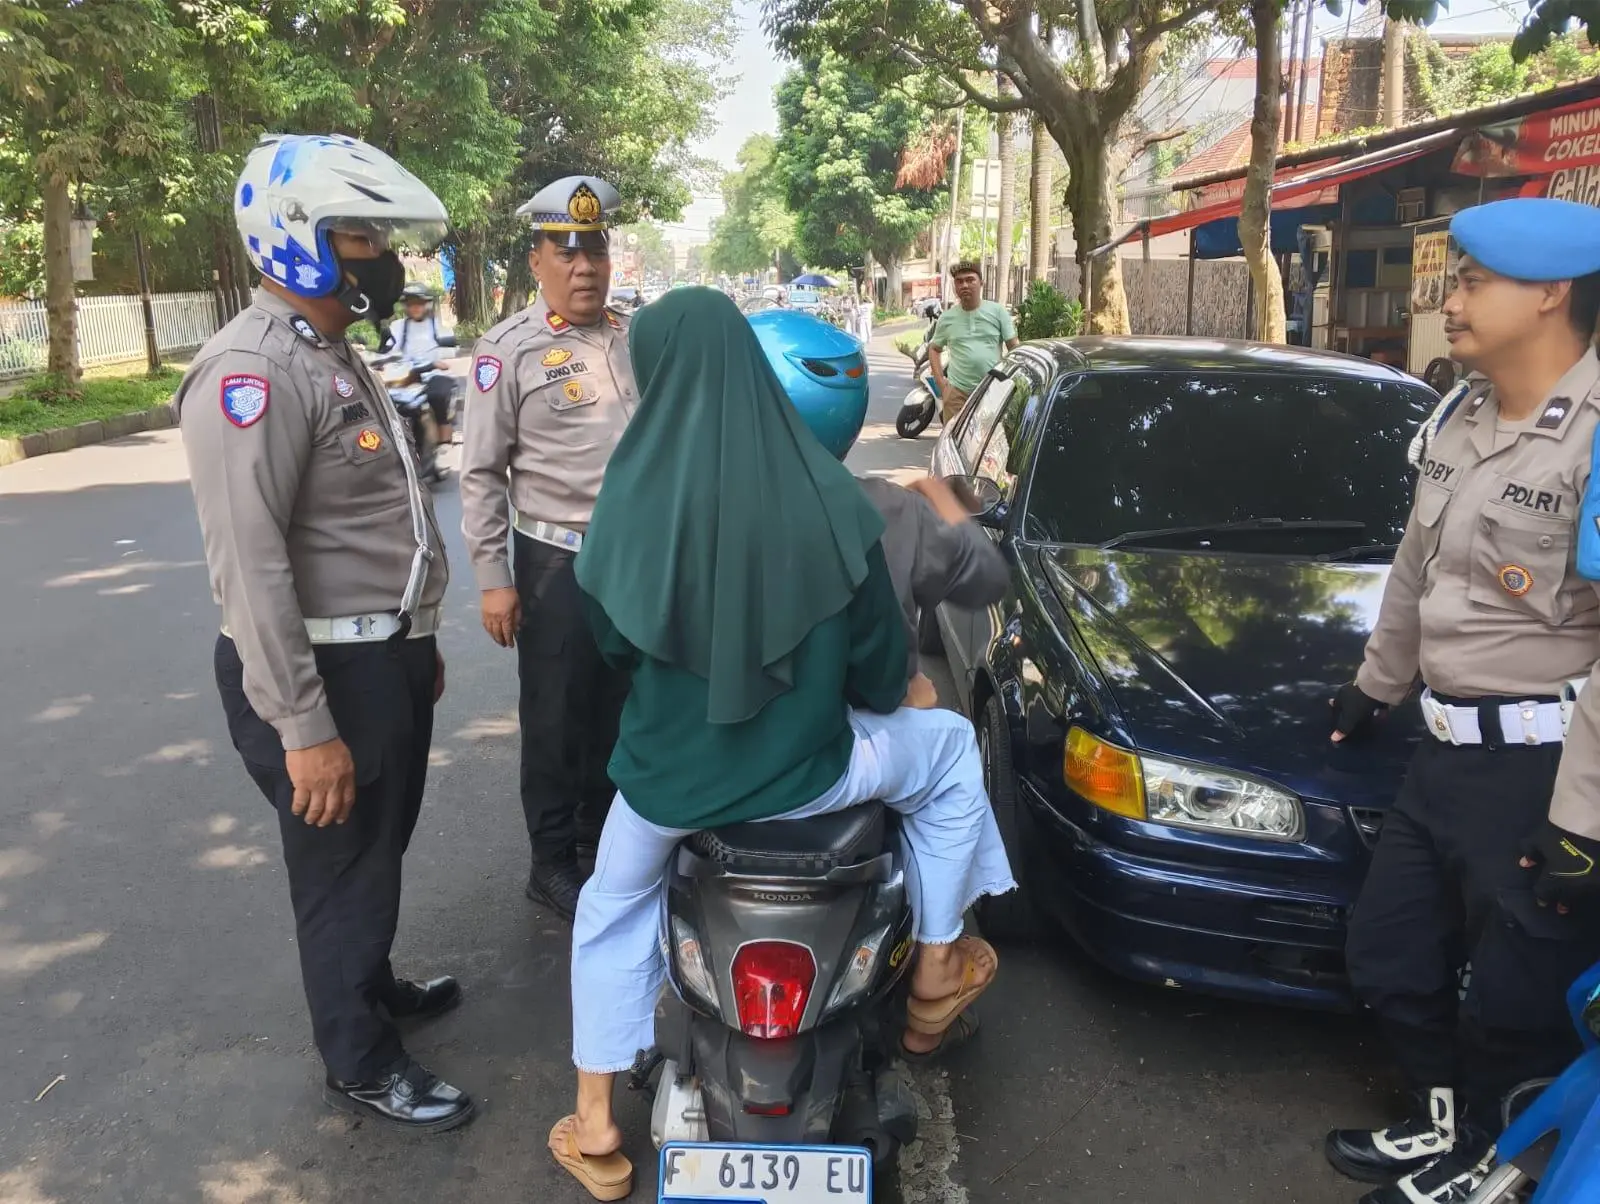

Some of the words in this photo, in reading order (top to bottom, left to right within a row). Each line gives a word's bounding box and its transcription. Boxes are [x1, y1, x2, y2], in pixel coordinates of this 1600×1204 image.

[545, 365, 570, 381] JOKO
[571, 360, 588, 373] EDI
[753, 892, 812, 902] HONDA
[665, 1150, 686, 1185] F
[718, 1152, 800, 1191] 6139
[826, 1157, 865, 1193] EU
